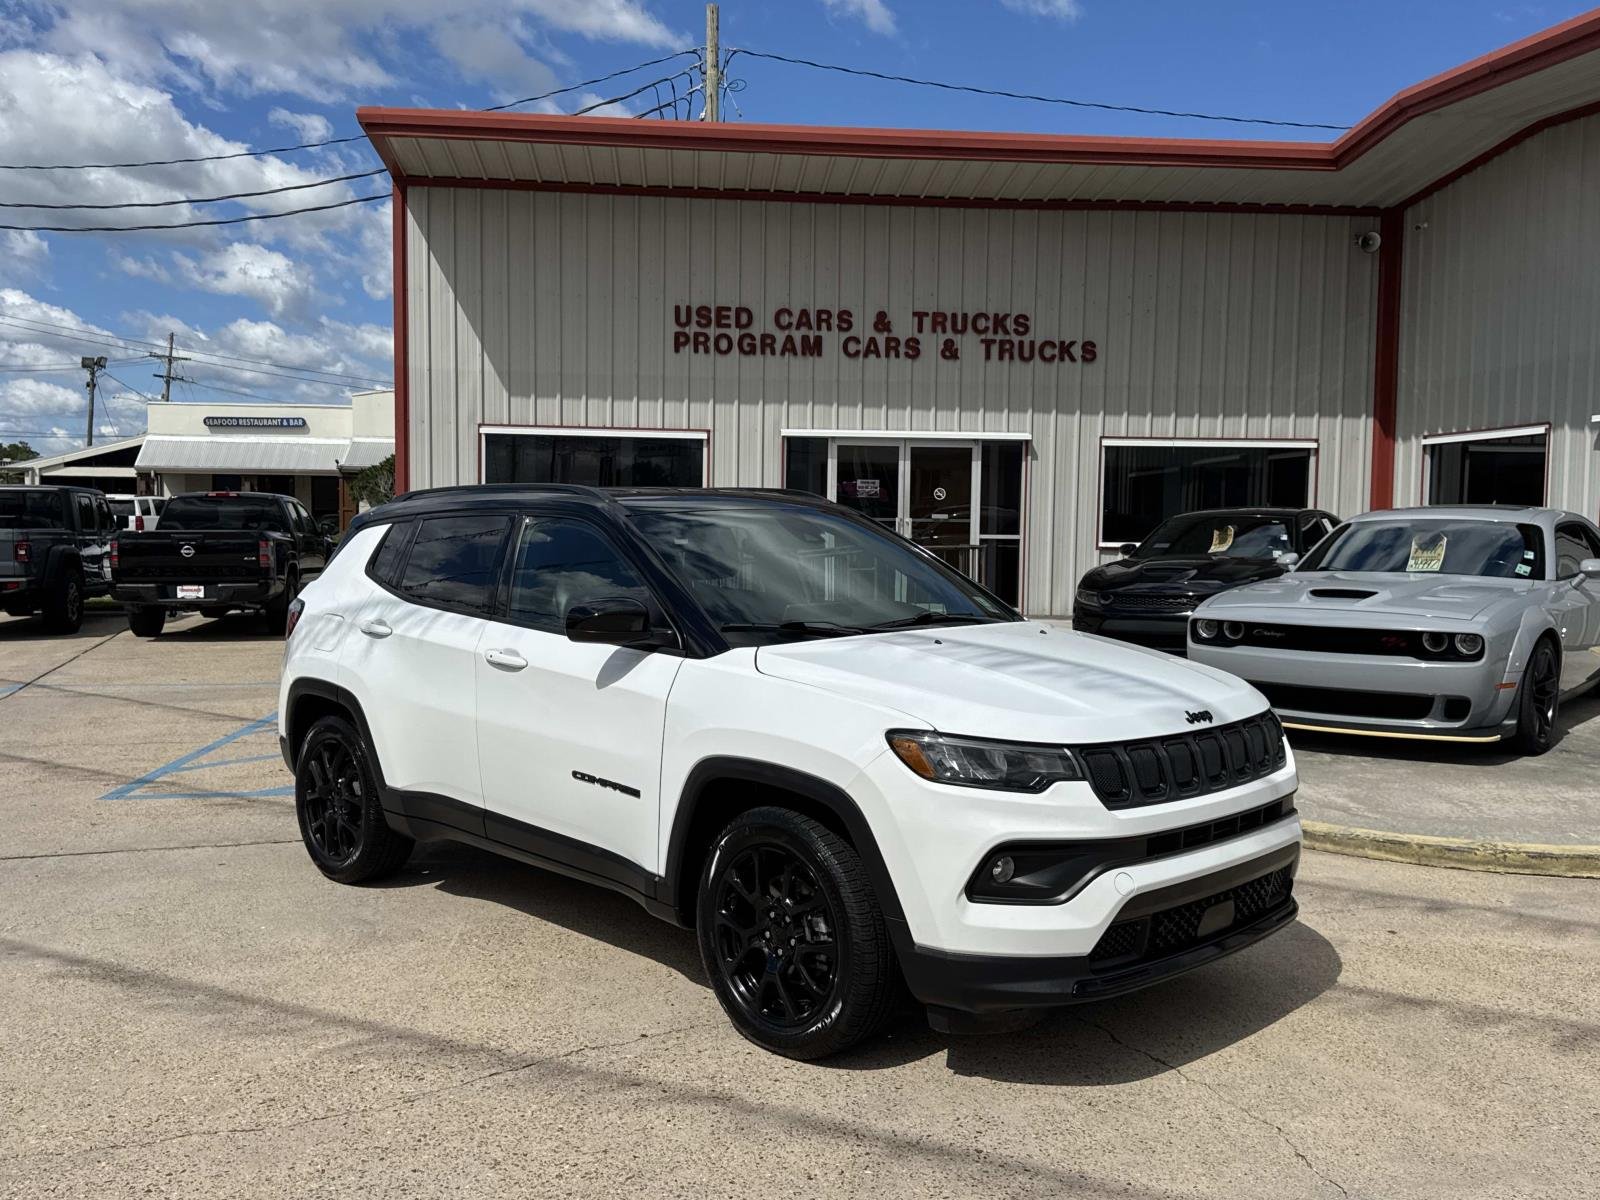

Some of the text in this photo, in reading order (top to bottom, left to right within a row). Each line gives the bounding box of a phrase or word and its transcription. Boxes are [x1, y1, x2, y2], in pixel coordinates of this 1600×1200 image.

[674, 304, 1031, 337] USED CARS & TRUCKS
[673, 331, 1098, 363] PROGRAM CARS & TRUCKS
[205, 418, 303, 426] SEAFOOD RESTAURANT & BAR
[1184, 710, 1213, 724] Jeep
